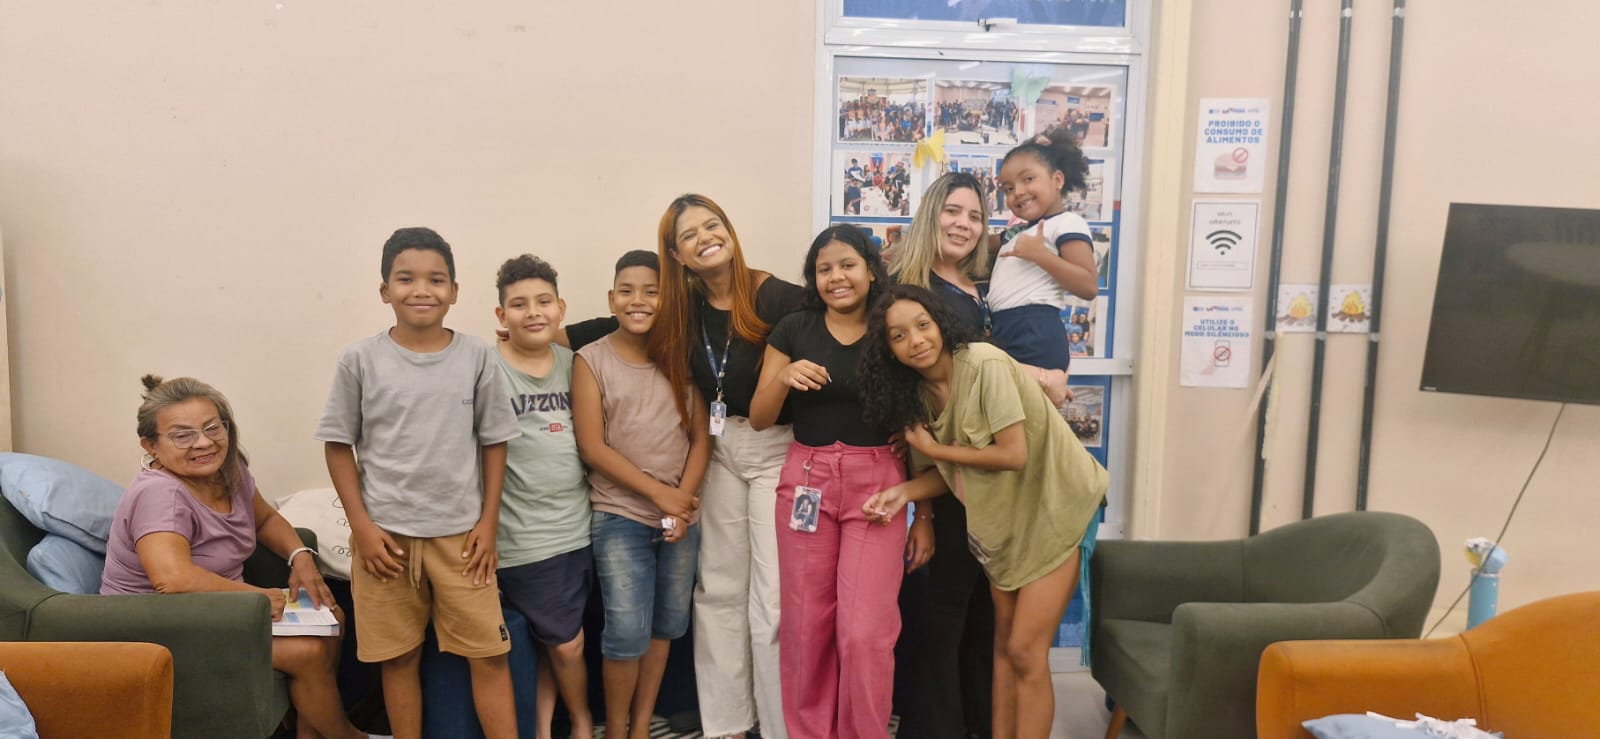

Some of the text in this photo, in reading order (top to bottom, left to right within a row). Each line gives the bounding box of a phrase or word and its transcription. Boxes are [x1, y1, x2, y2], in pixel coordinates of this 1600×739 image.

[1204, 128, 1263, 136] CONSUMO DE
[1206, 136, 1260, 144] ALIMENTOS
